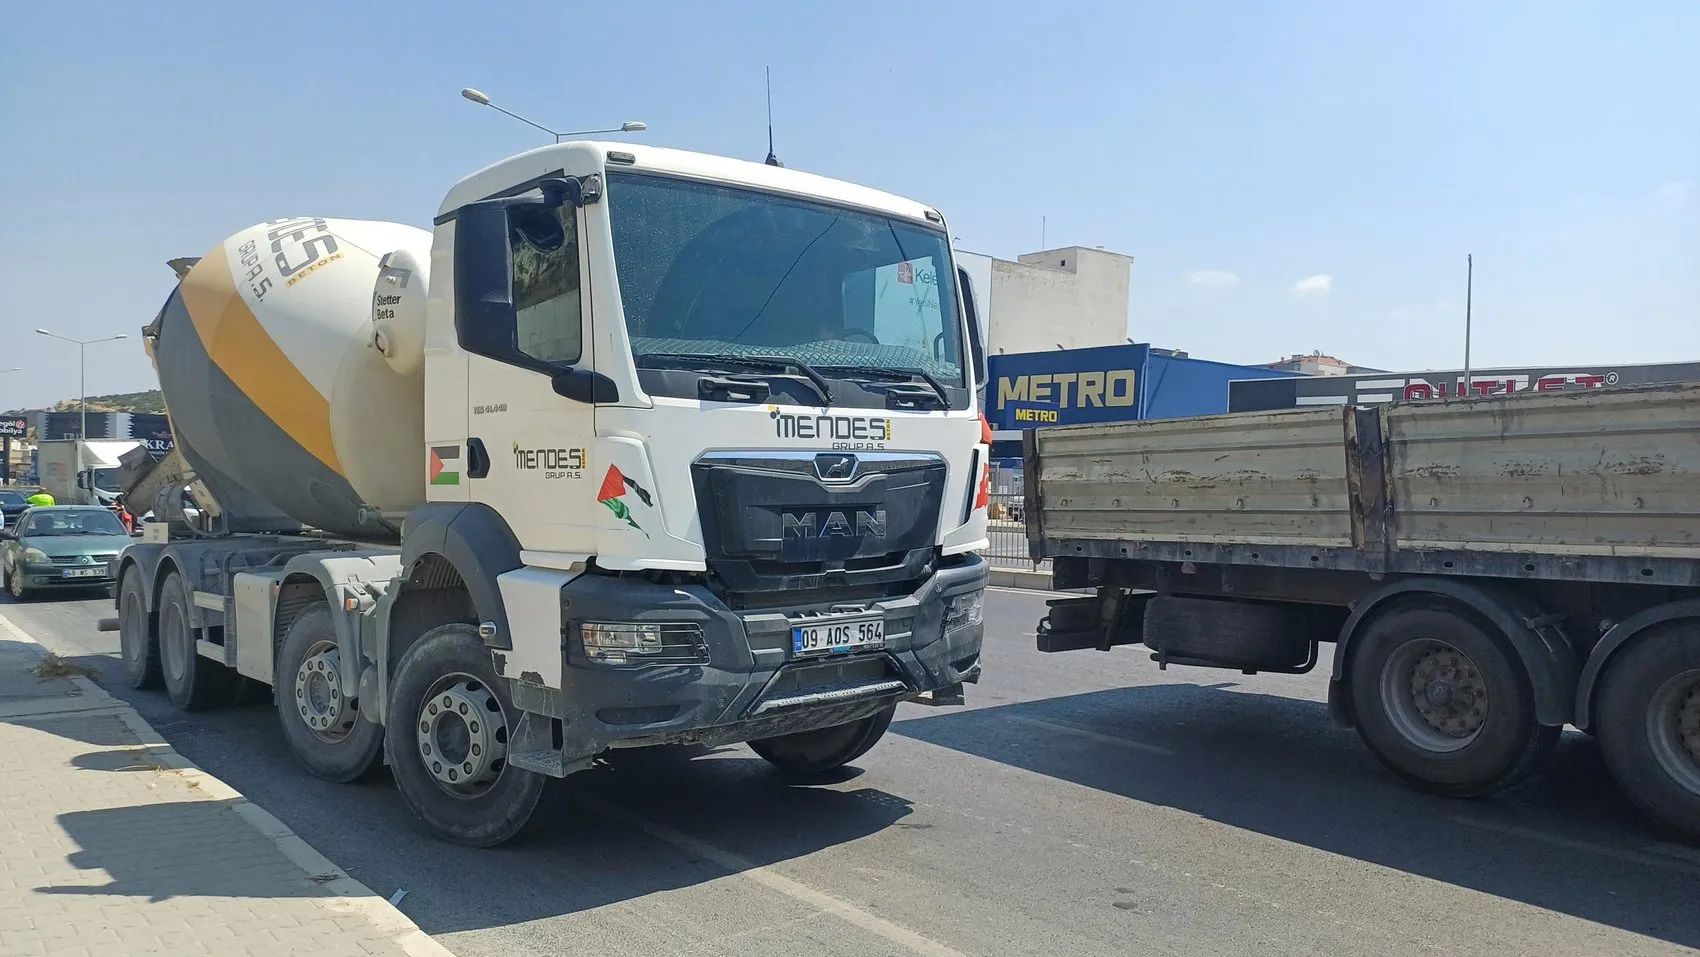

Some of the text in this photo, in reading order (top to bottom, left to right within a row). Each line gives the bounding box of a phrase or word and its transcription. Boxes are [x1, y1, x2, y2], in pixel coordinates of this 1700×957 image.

[287, 253, 341, 286] BETON
[377, 294, 401, 306] Stetter
[377, 308, 395, 320] Beta
[997, 369, 1136, 410] METRO
[1015, 408, 1058, 423] METRO
[776, 414, 886, 440] MENDES
[832, 442, 864, 451] GRUP
[515, 448, 581, 469] MENDES
[545, 471, 566, 479] GRUP
[781, 510, 887, 539] MAN
[802, 622, 882, 649] 09 AOS 564
